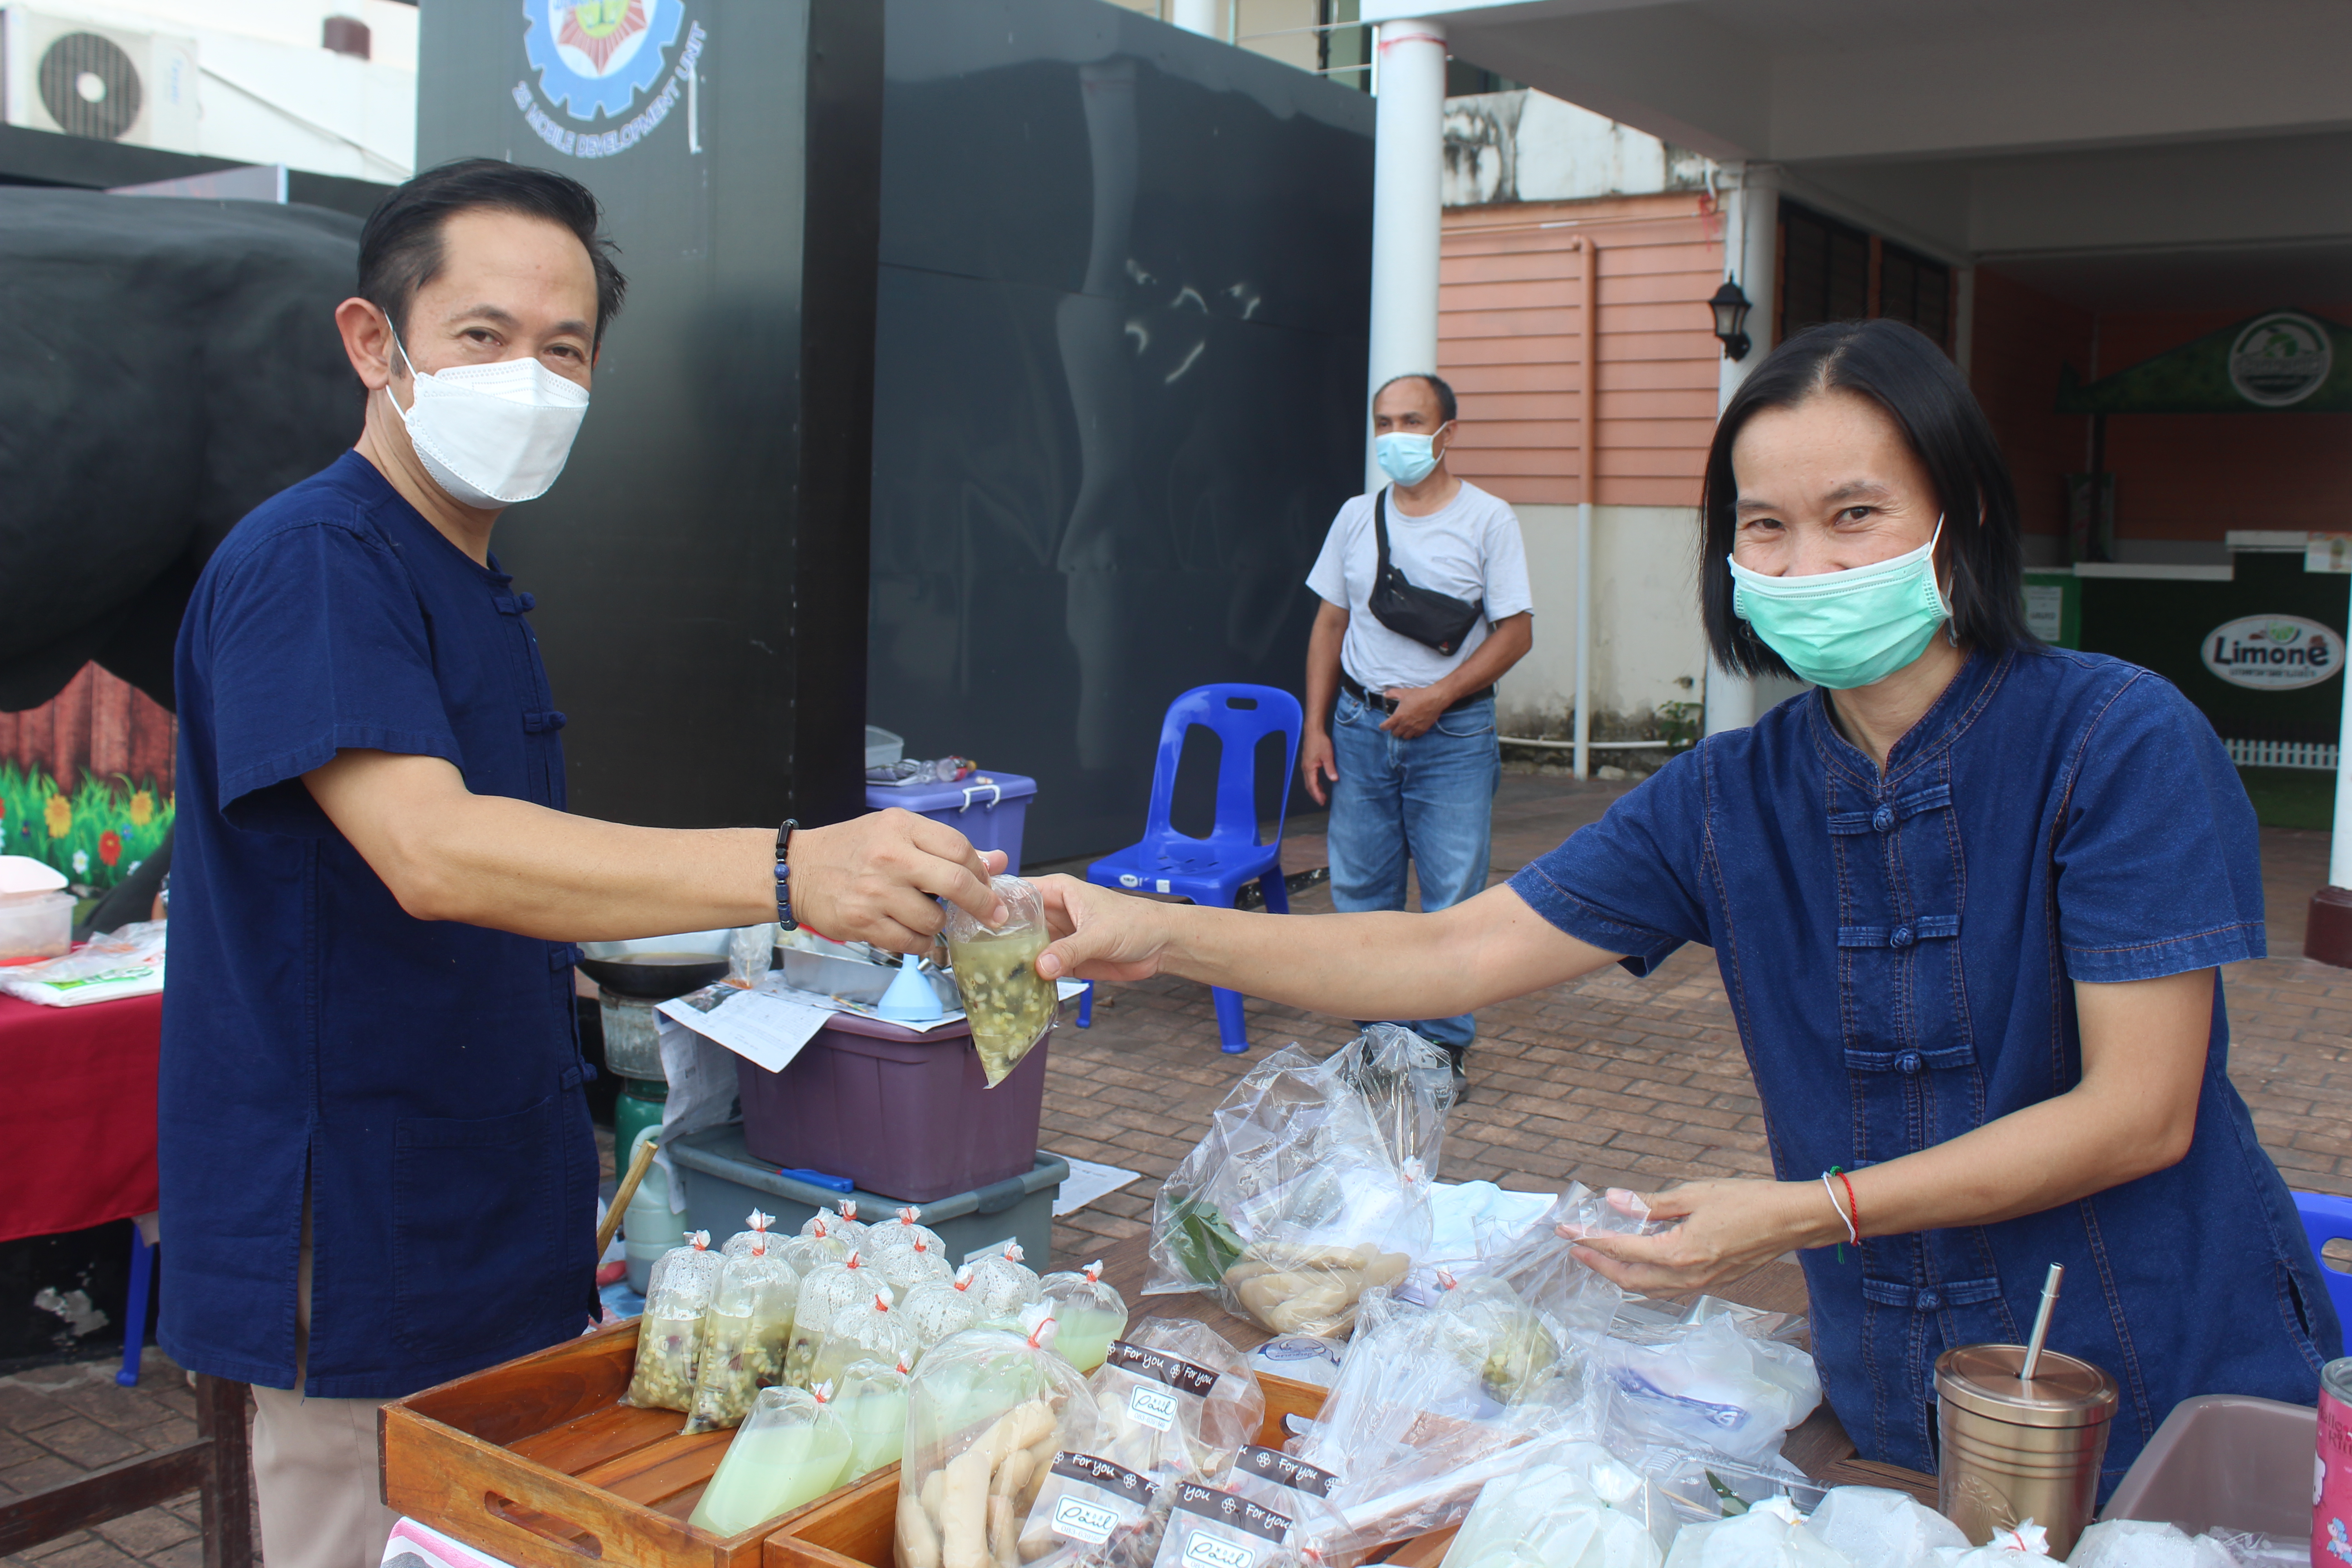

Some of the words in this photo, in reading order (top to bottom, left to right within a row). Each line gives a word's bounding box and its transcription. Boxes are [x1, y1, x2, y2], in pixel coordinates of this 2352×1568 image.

[525, 103, 576, 156] MOBILE
[575, 76, 681, 158] DEVELOPMENT
[675, 20, 706, 81] UNIT
[2214, 636, 2329, 666] Limone
[1123, 1346, 1142, 1360] For
[1142, 1353, 1164, 1368] you
[1184, 1367, 1196, 1380] For
[1194, 1372, 1213, 1387] you
[1073, 1454, 1092, 1467] For
[1092, 1460, 1114, 1476] you
[1279, 1457, 1298, 1472] For
[1296, 1466, 1318, 1480] you
[1184, 1485, 1210, 1501] you
[1246, 1503, 1265, 1519] For
[1264, 1513, 1289, 1529] you
